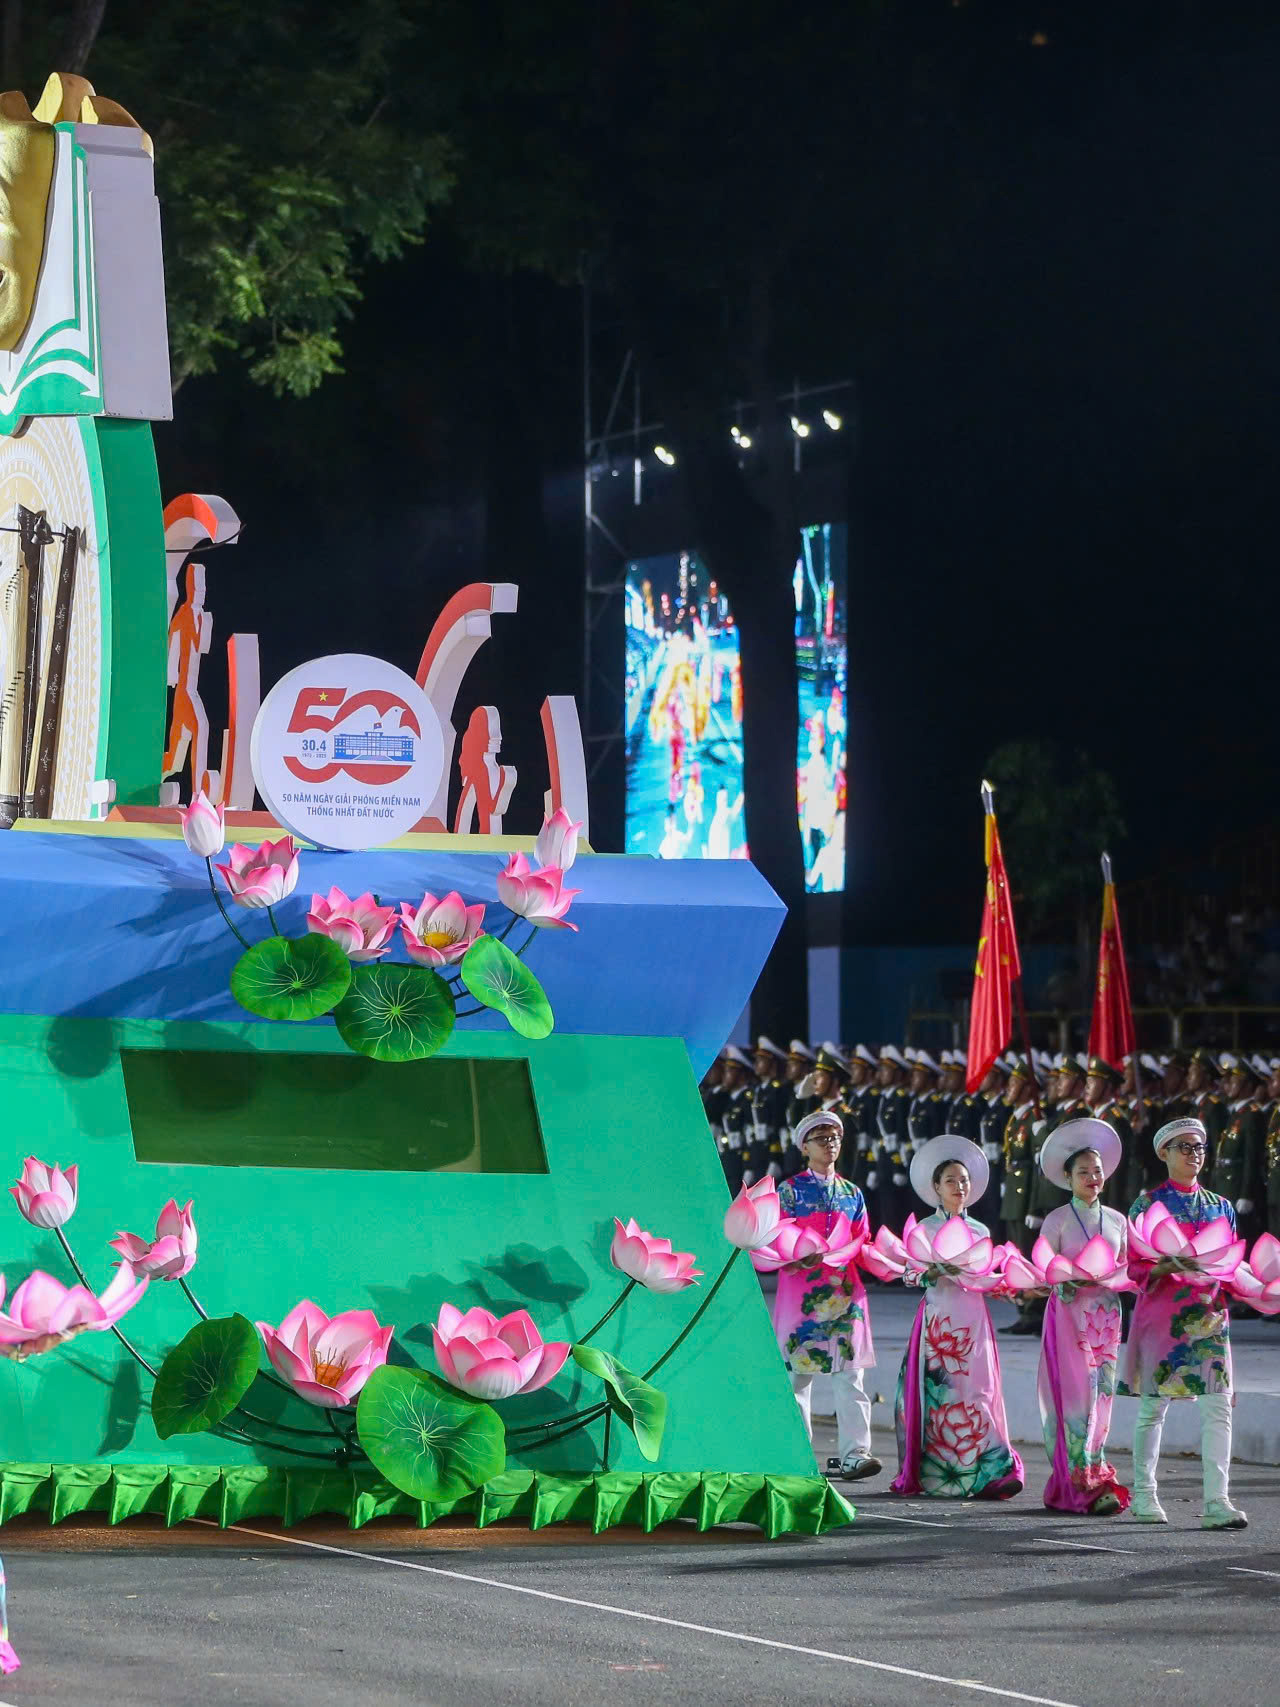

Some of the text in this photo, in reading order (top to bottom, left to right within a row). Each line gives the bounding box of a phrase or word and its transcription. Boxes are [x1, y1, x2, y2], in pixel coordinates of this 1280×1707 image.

[302, 739, 326, 751] 30.4
[282, 793, 292, 802] 50
[313, 793, 334, 803] NGÀY
[335, 793, 351, 804] GIẢI
[352, 794, 380, 805] PHÓNG
[402, 797, 421, 807] NAM
[373, 807, 395, 818] NƯỚC
